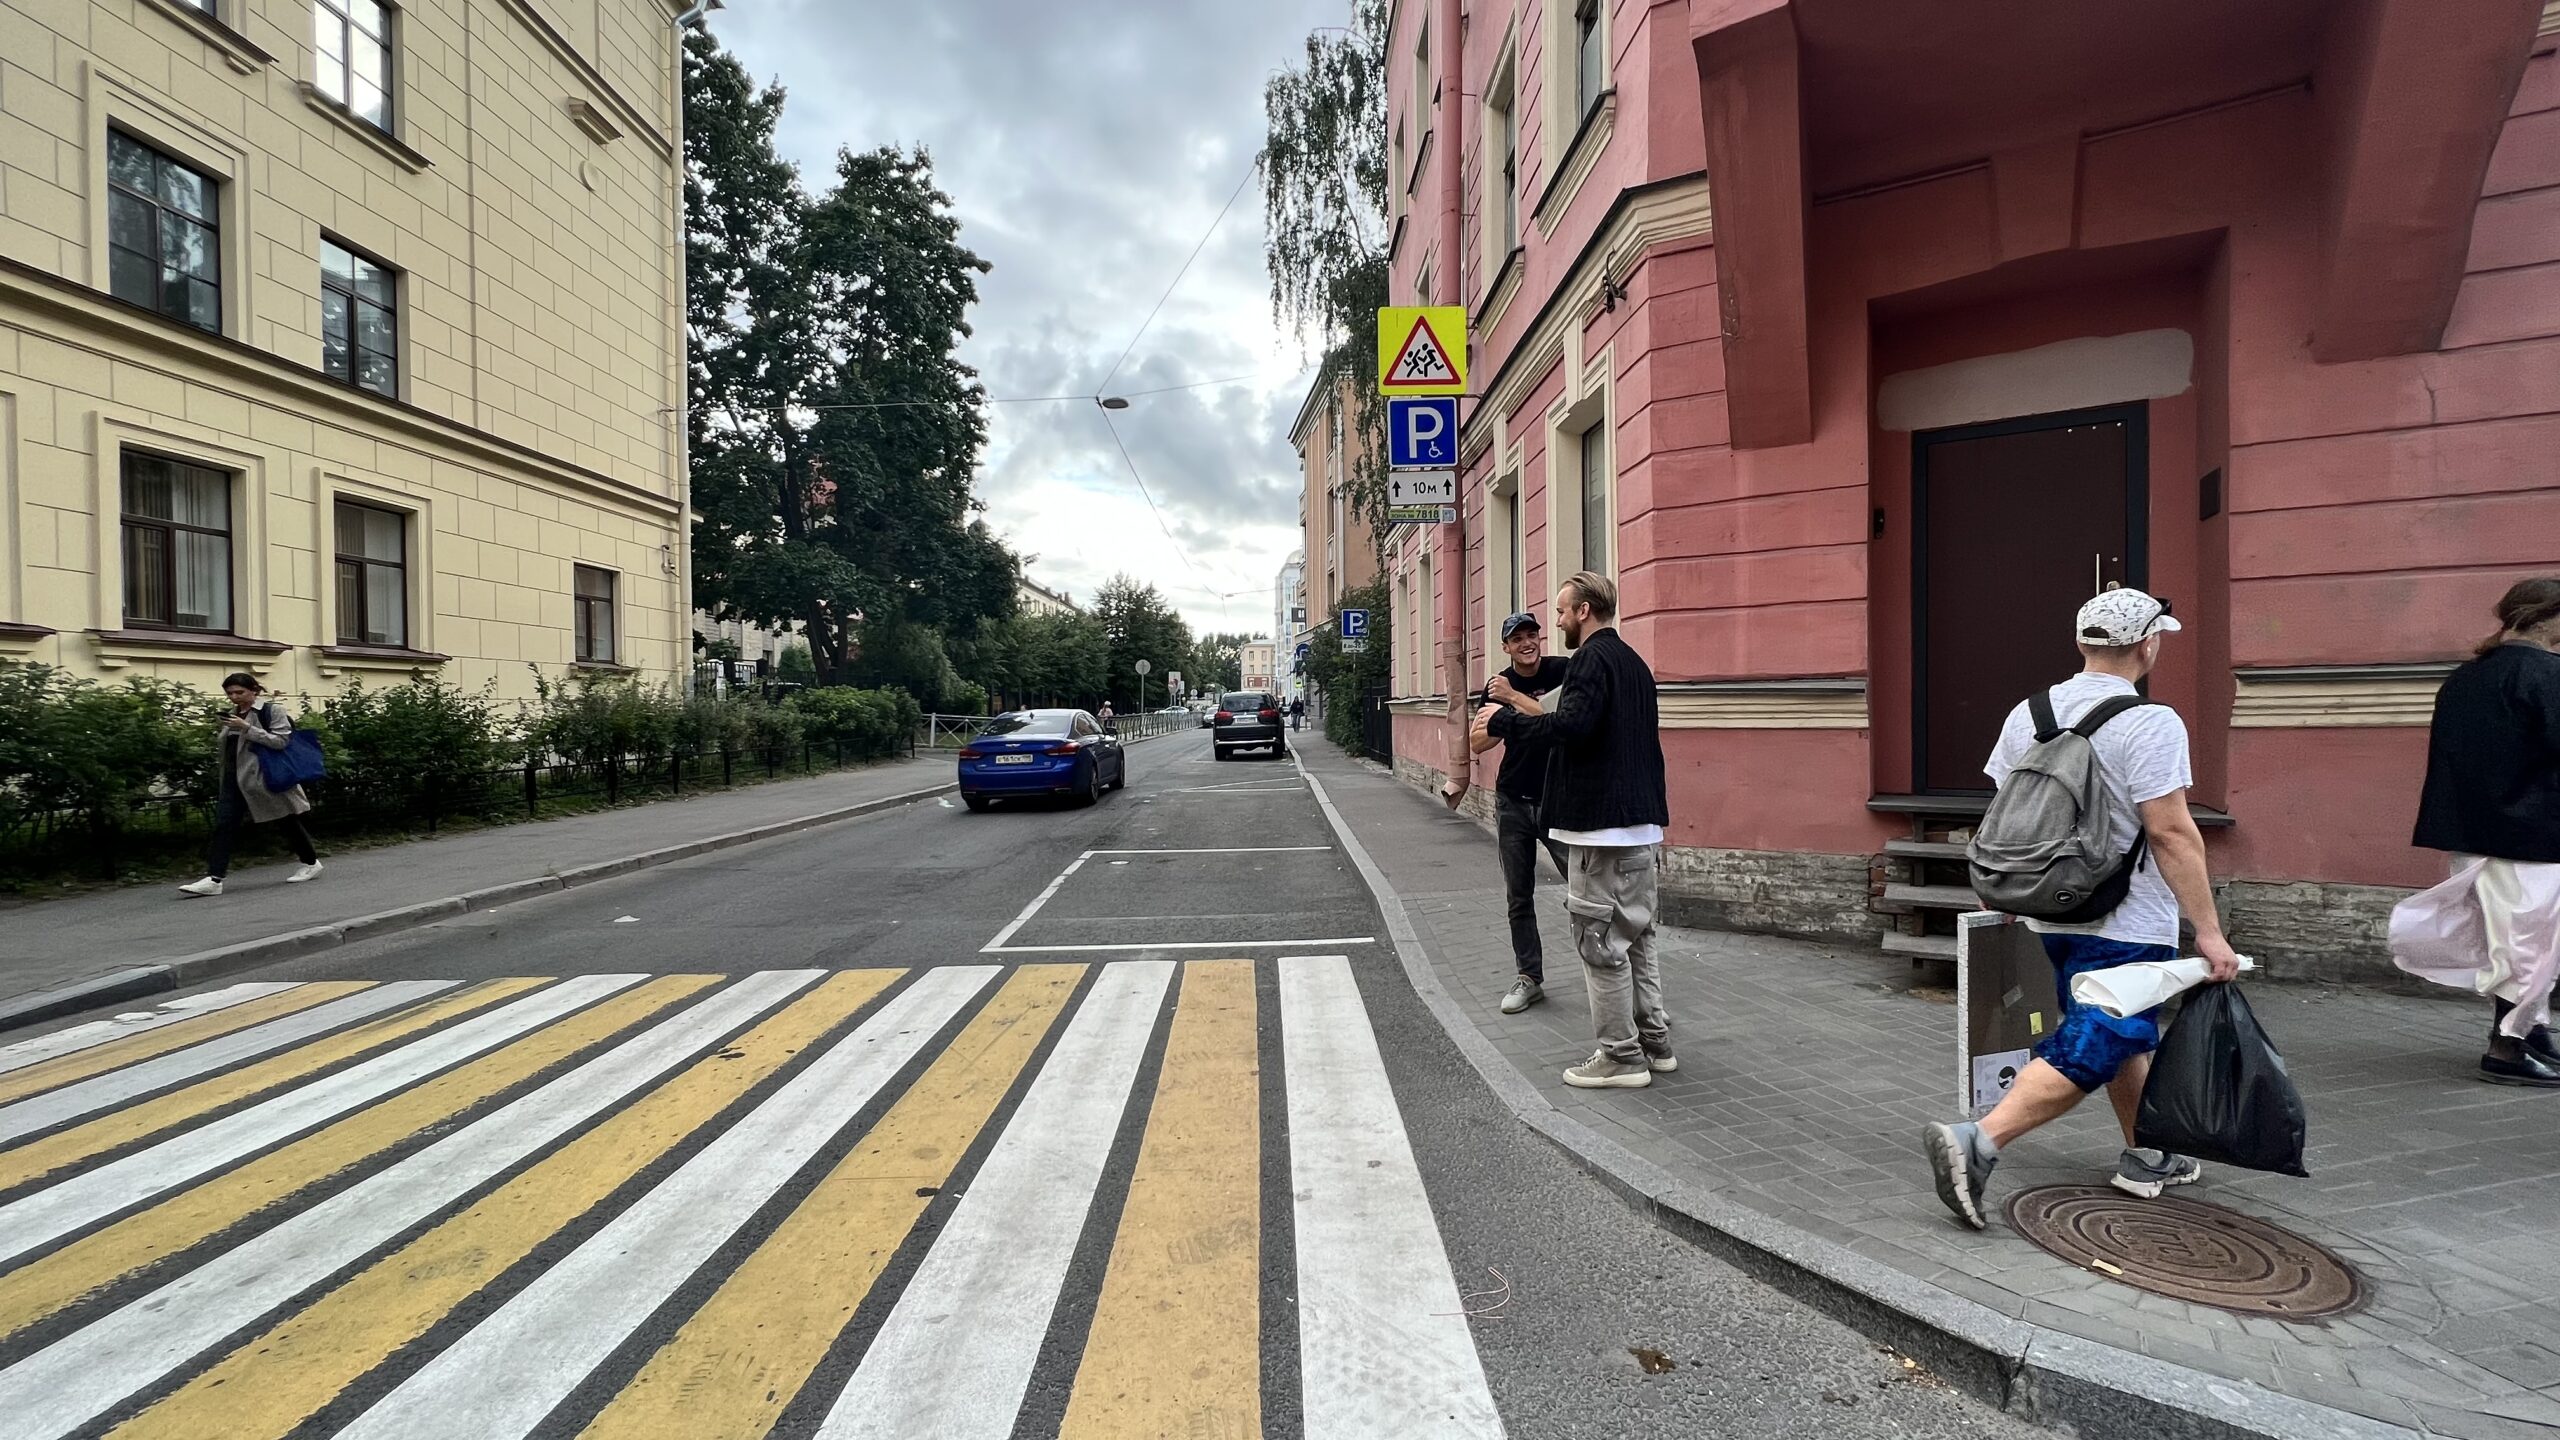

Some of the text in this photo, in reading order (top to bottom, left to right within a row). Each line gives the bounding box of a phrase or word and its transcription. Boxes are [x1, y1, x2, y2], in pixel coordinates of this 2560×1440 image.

[1407, 406, 1444, 459] P
[1412, 481, 1437, 495] 10м
[1415, 509, 1439, 519] 7818
[1349, 612, 1364, 634] P
